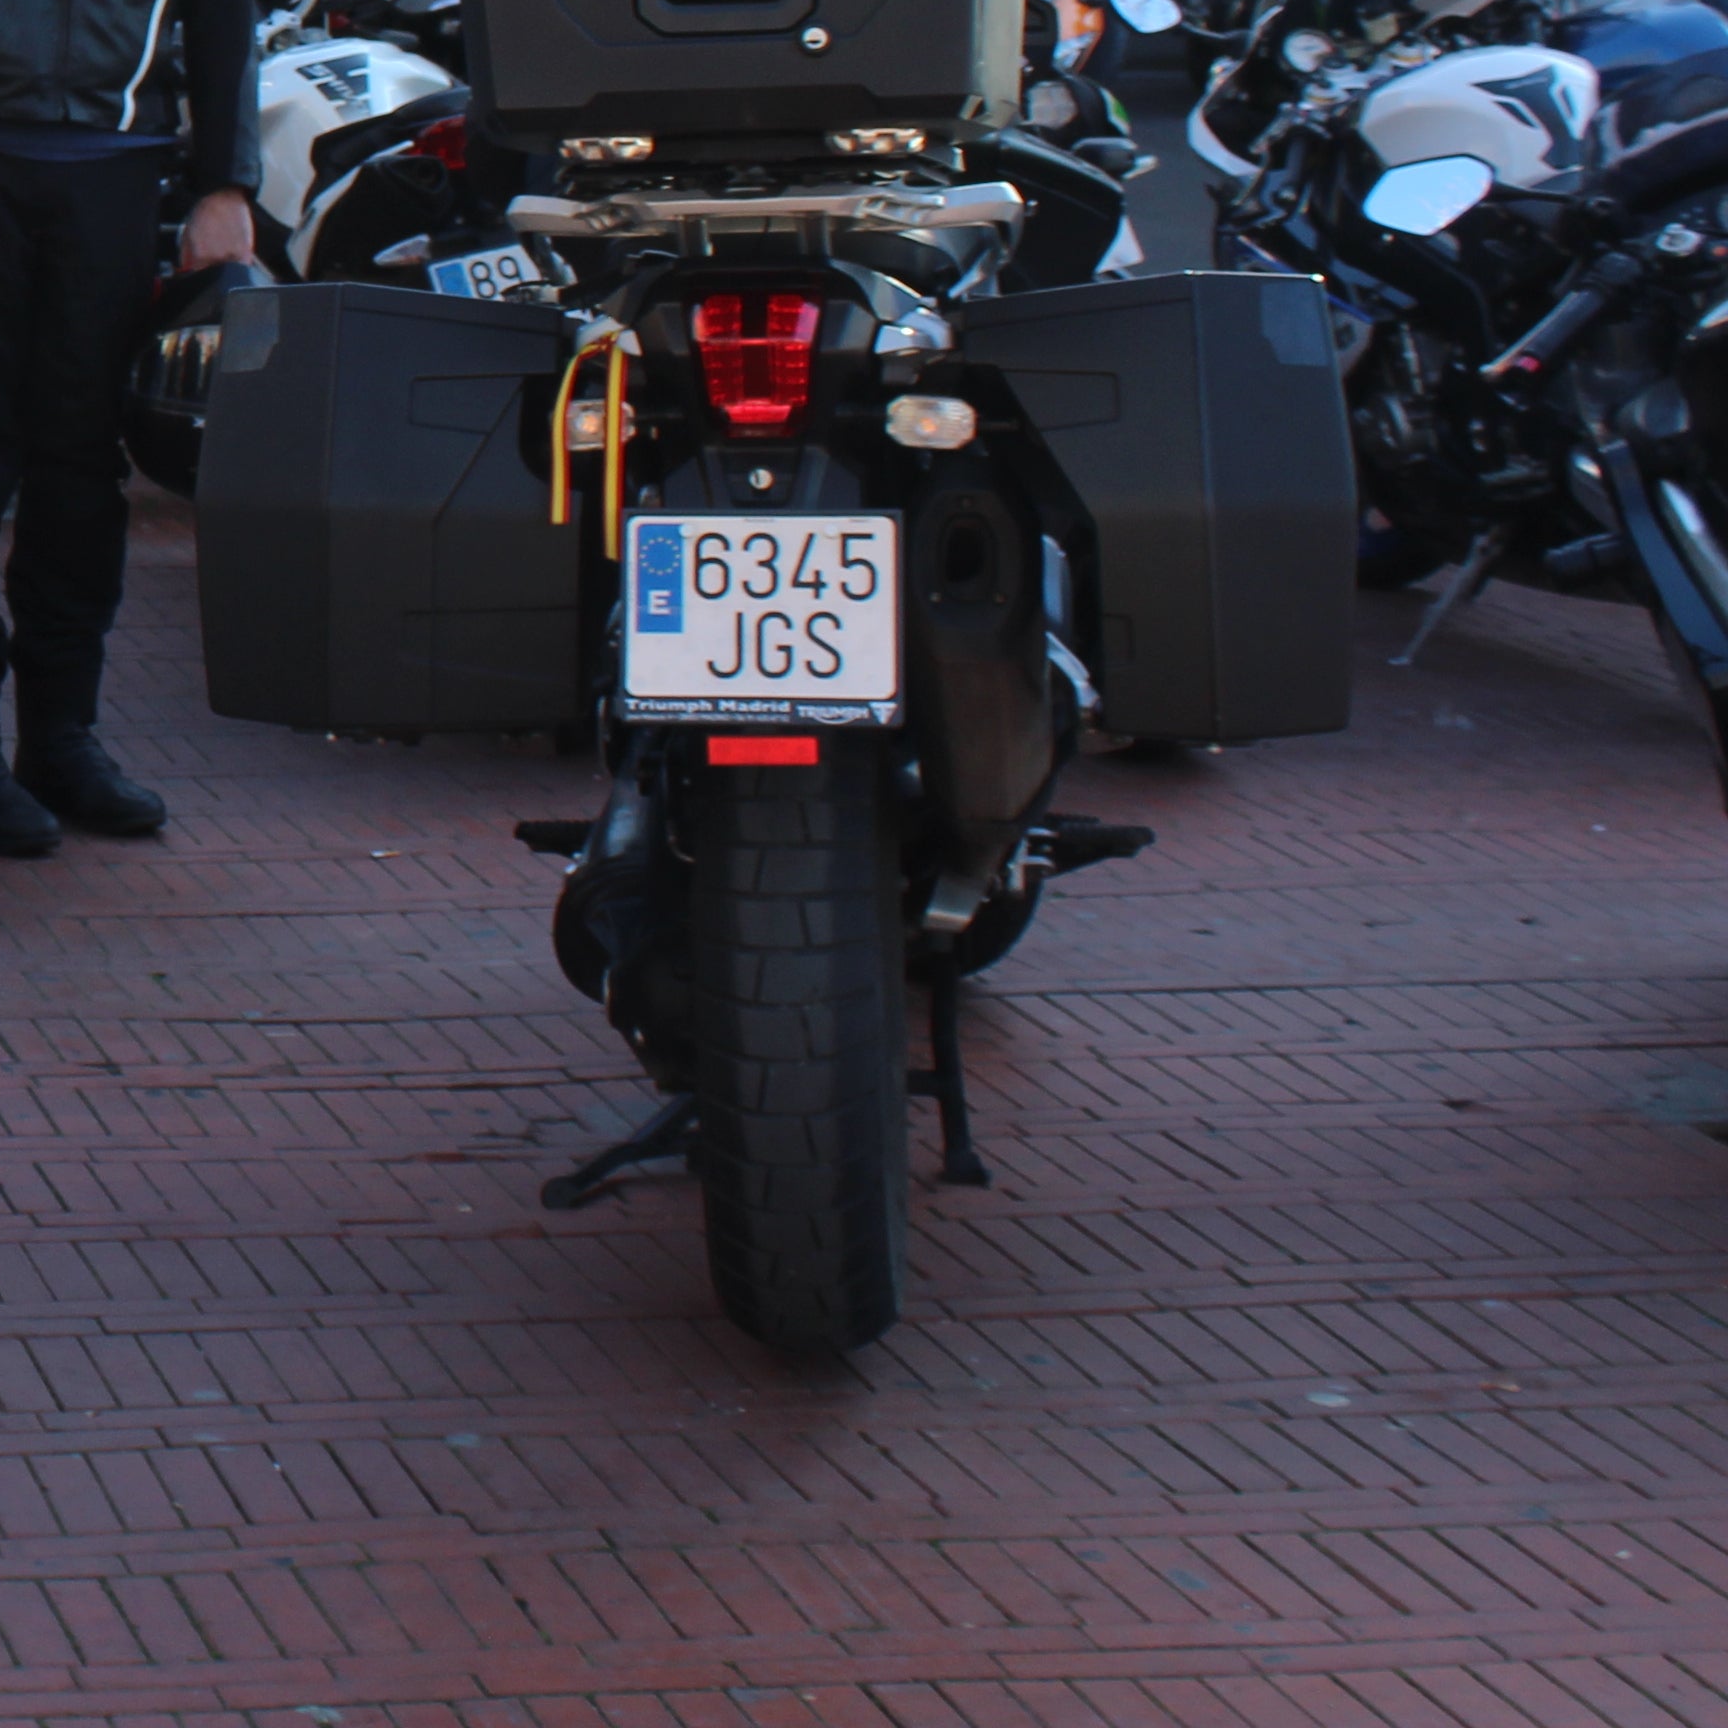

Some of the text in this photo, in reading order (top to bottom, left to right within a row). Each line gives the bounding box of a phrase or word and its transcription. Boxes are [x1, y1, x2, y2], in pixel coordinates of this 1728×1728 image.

[694, 532, 877, 601] 6345
[647, 590, 671, 614] E
[707, 611, 844, 679] JGS
[624, 698, 791, 713] Triumph Madrid
